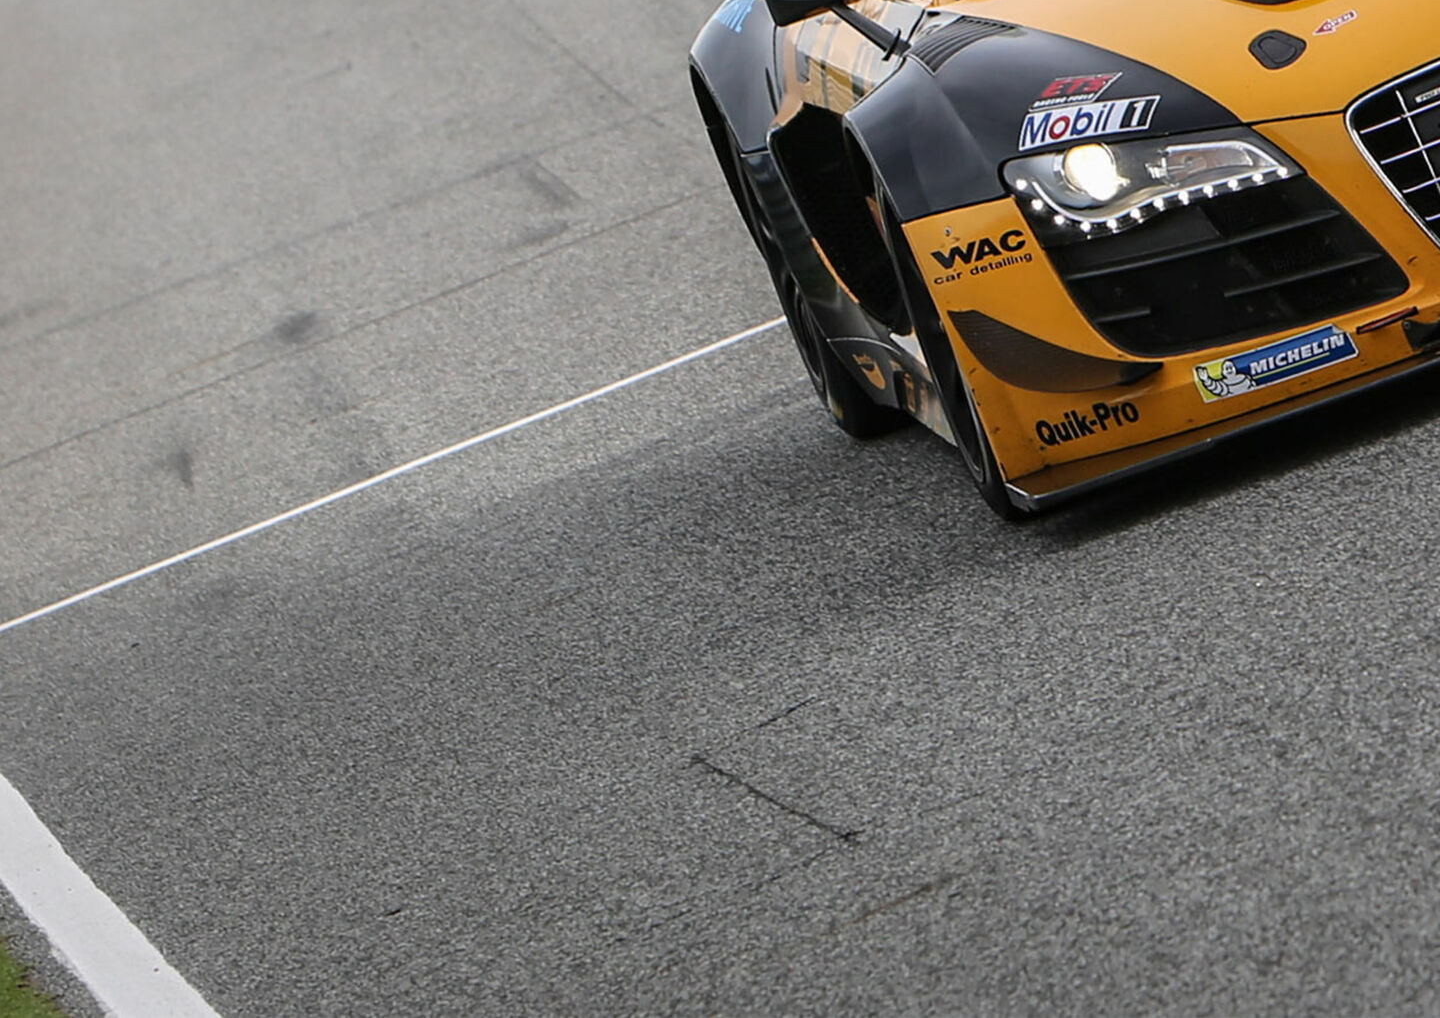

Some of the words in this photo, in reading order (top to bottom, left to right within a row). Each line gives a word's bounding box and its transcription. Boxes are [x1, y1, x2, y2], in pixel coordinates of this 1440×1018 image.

[1021, 102, 1116, 148] Mobil
[1129, 101, 1147, 127] 1
[930, 229, 1026, 270] WAC
[934, 271, 963, 285] car
[1250, 333, 1346, 376] MICHELIN
[1035, 402, 1139, 446] Quik-Pro
